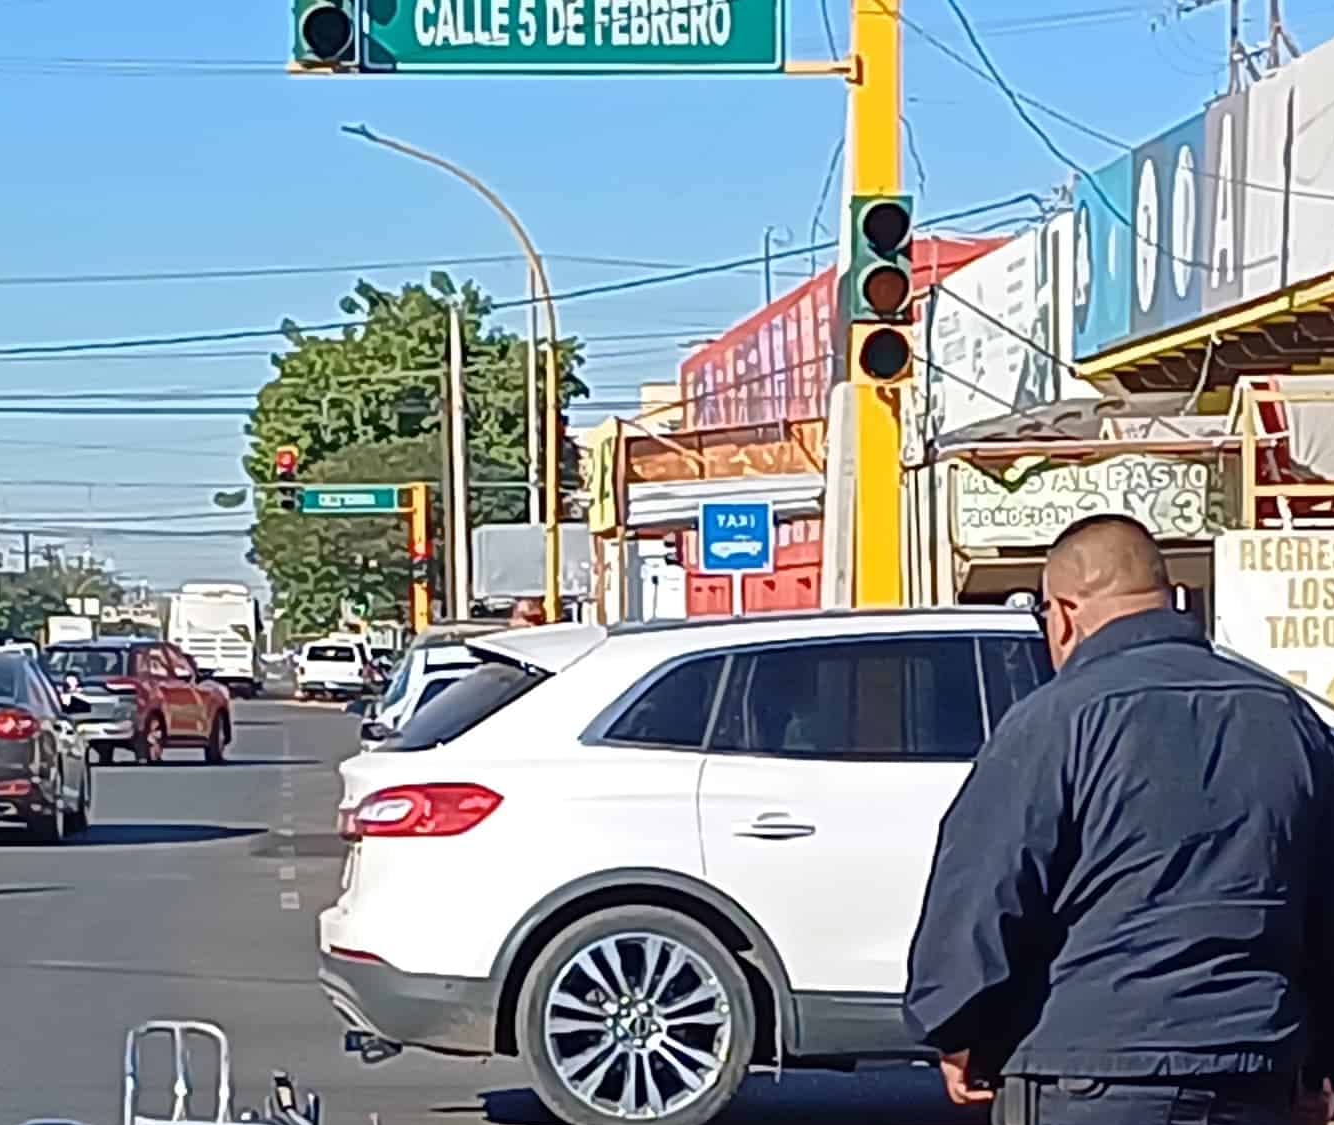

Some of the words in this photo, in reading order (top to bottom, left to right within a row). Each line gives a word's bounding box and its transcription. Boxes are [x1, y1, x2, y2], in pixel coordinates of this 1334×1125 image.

[414, 0, 510, 46] CALLE
[517, 0, 537, 46] 5
[546, 0, 586, 46] DE
[594, 0, 731, 46] FEBRERO
[716, 513, 756, 529] TAXI
